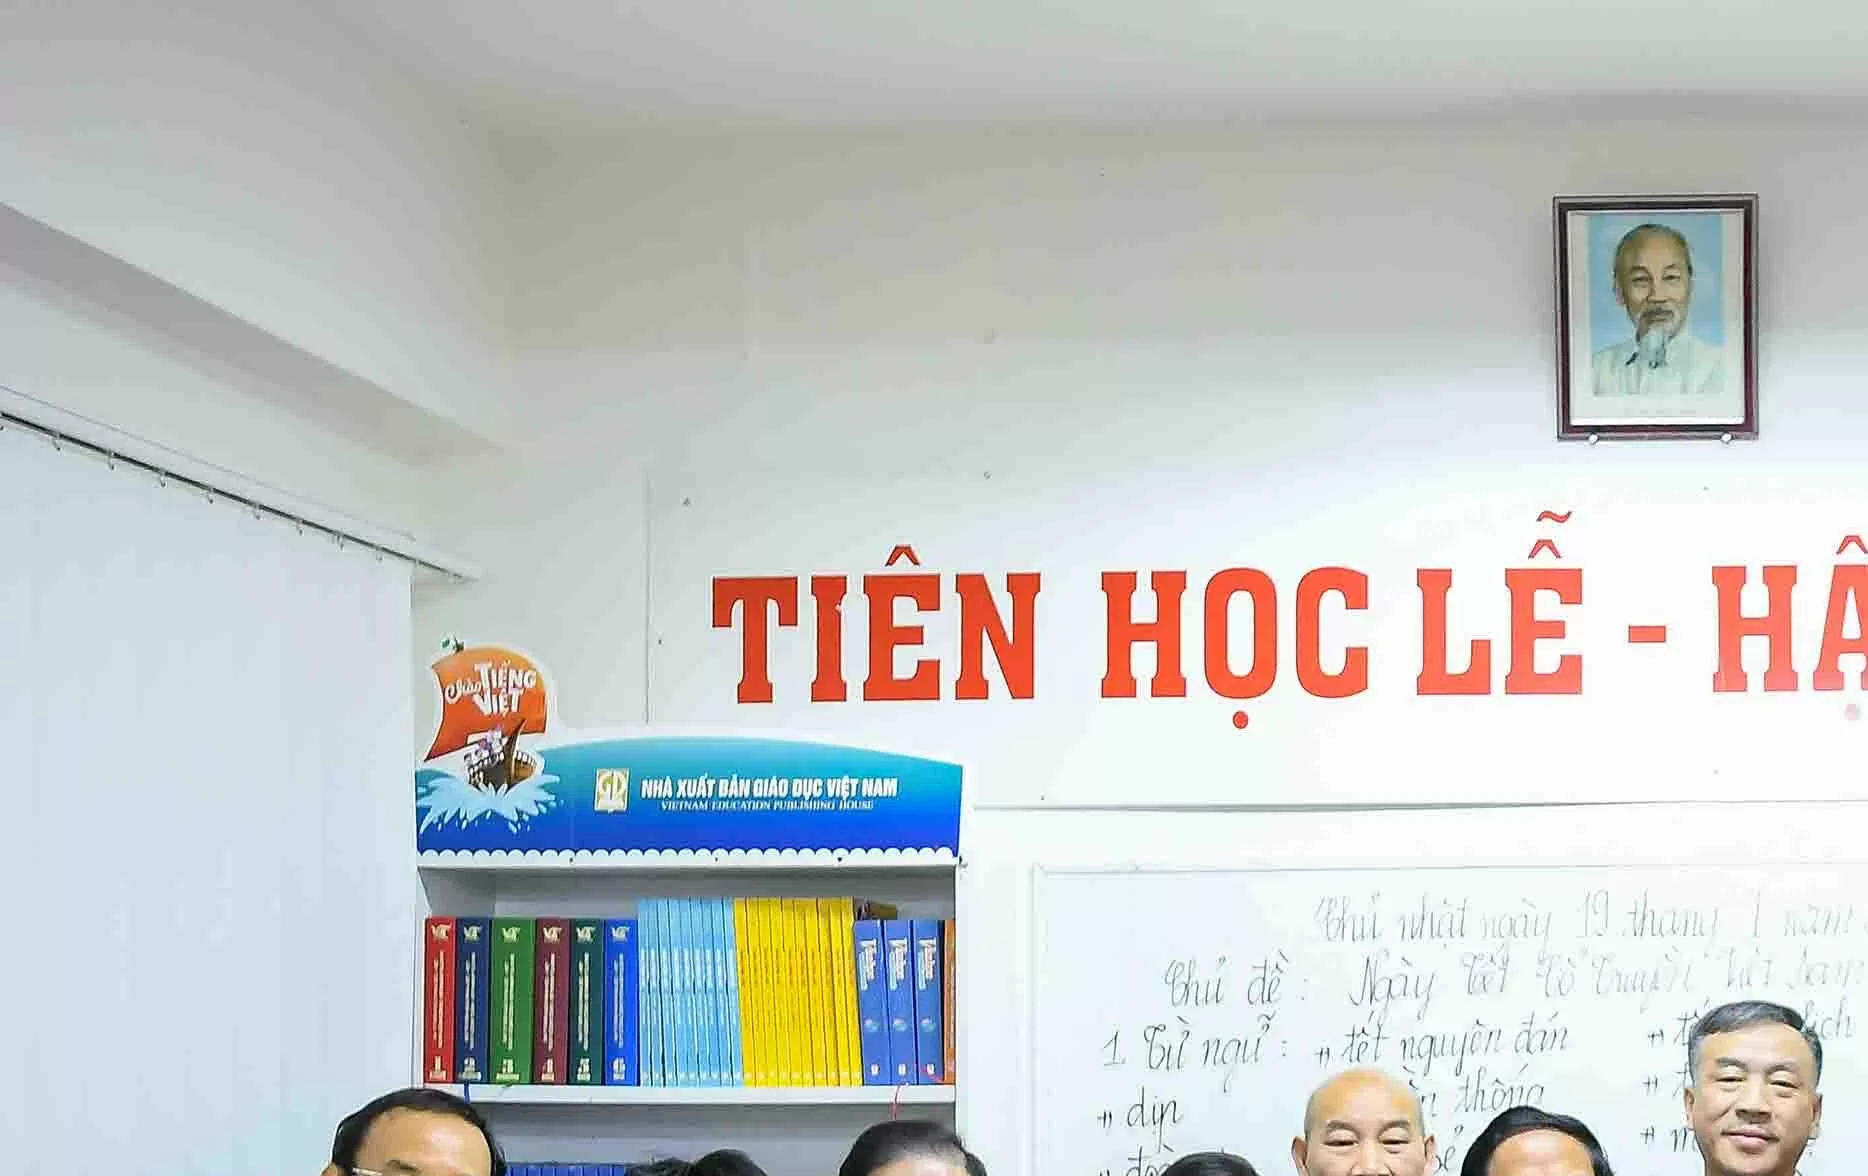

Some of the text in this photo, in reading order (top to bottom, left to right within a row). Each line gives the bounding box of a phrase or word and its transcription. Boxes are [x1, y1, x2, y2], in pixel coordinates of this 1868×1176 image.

[1101, 566, 1369, 729] HỌC
[1416, 511, 1583, 696] LỄ
[474, 659, 537, 690] TIẾNG
[473, 688, 524, 717] VIỆT
[640, 775, 673, 798] NHÀ
[676, 771, 715, 798] XUẤT
[752, 775, 788, 798] GIÁO
[792, 777, 823, 801] DỤC
[827, 774, 857, 801] VIỆT
[861, 777, 898, 797] NAM
[661, 798, 874, 811] VIETNAM EDUCATION PUBLISHING HOUSE
